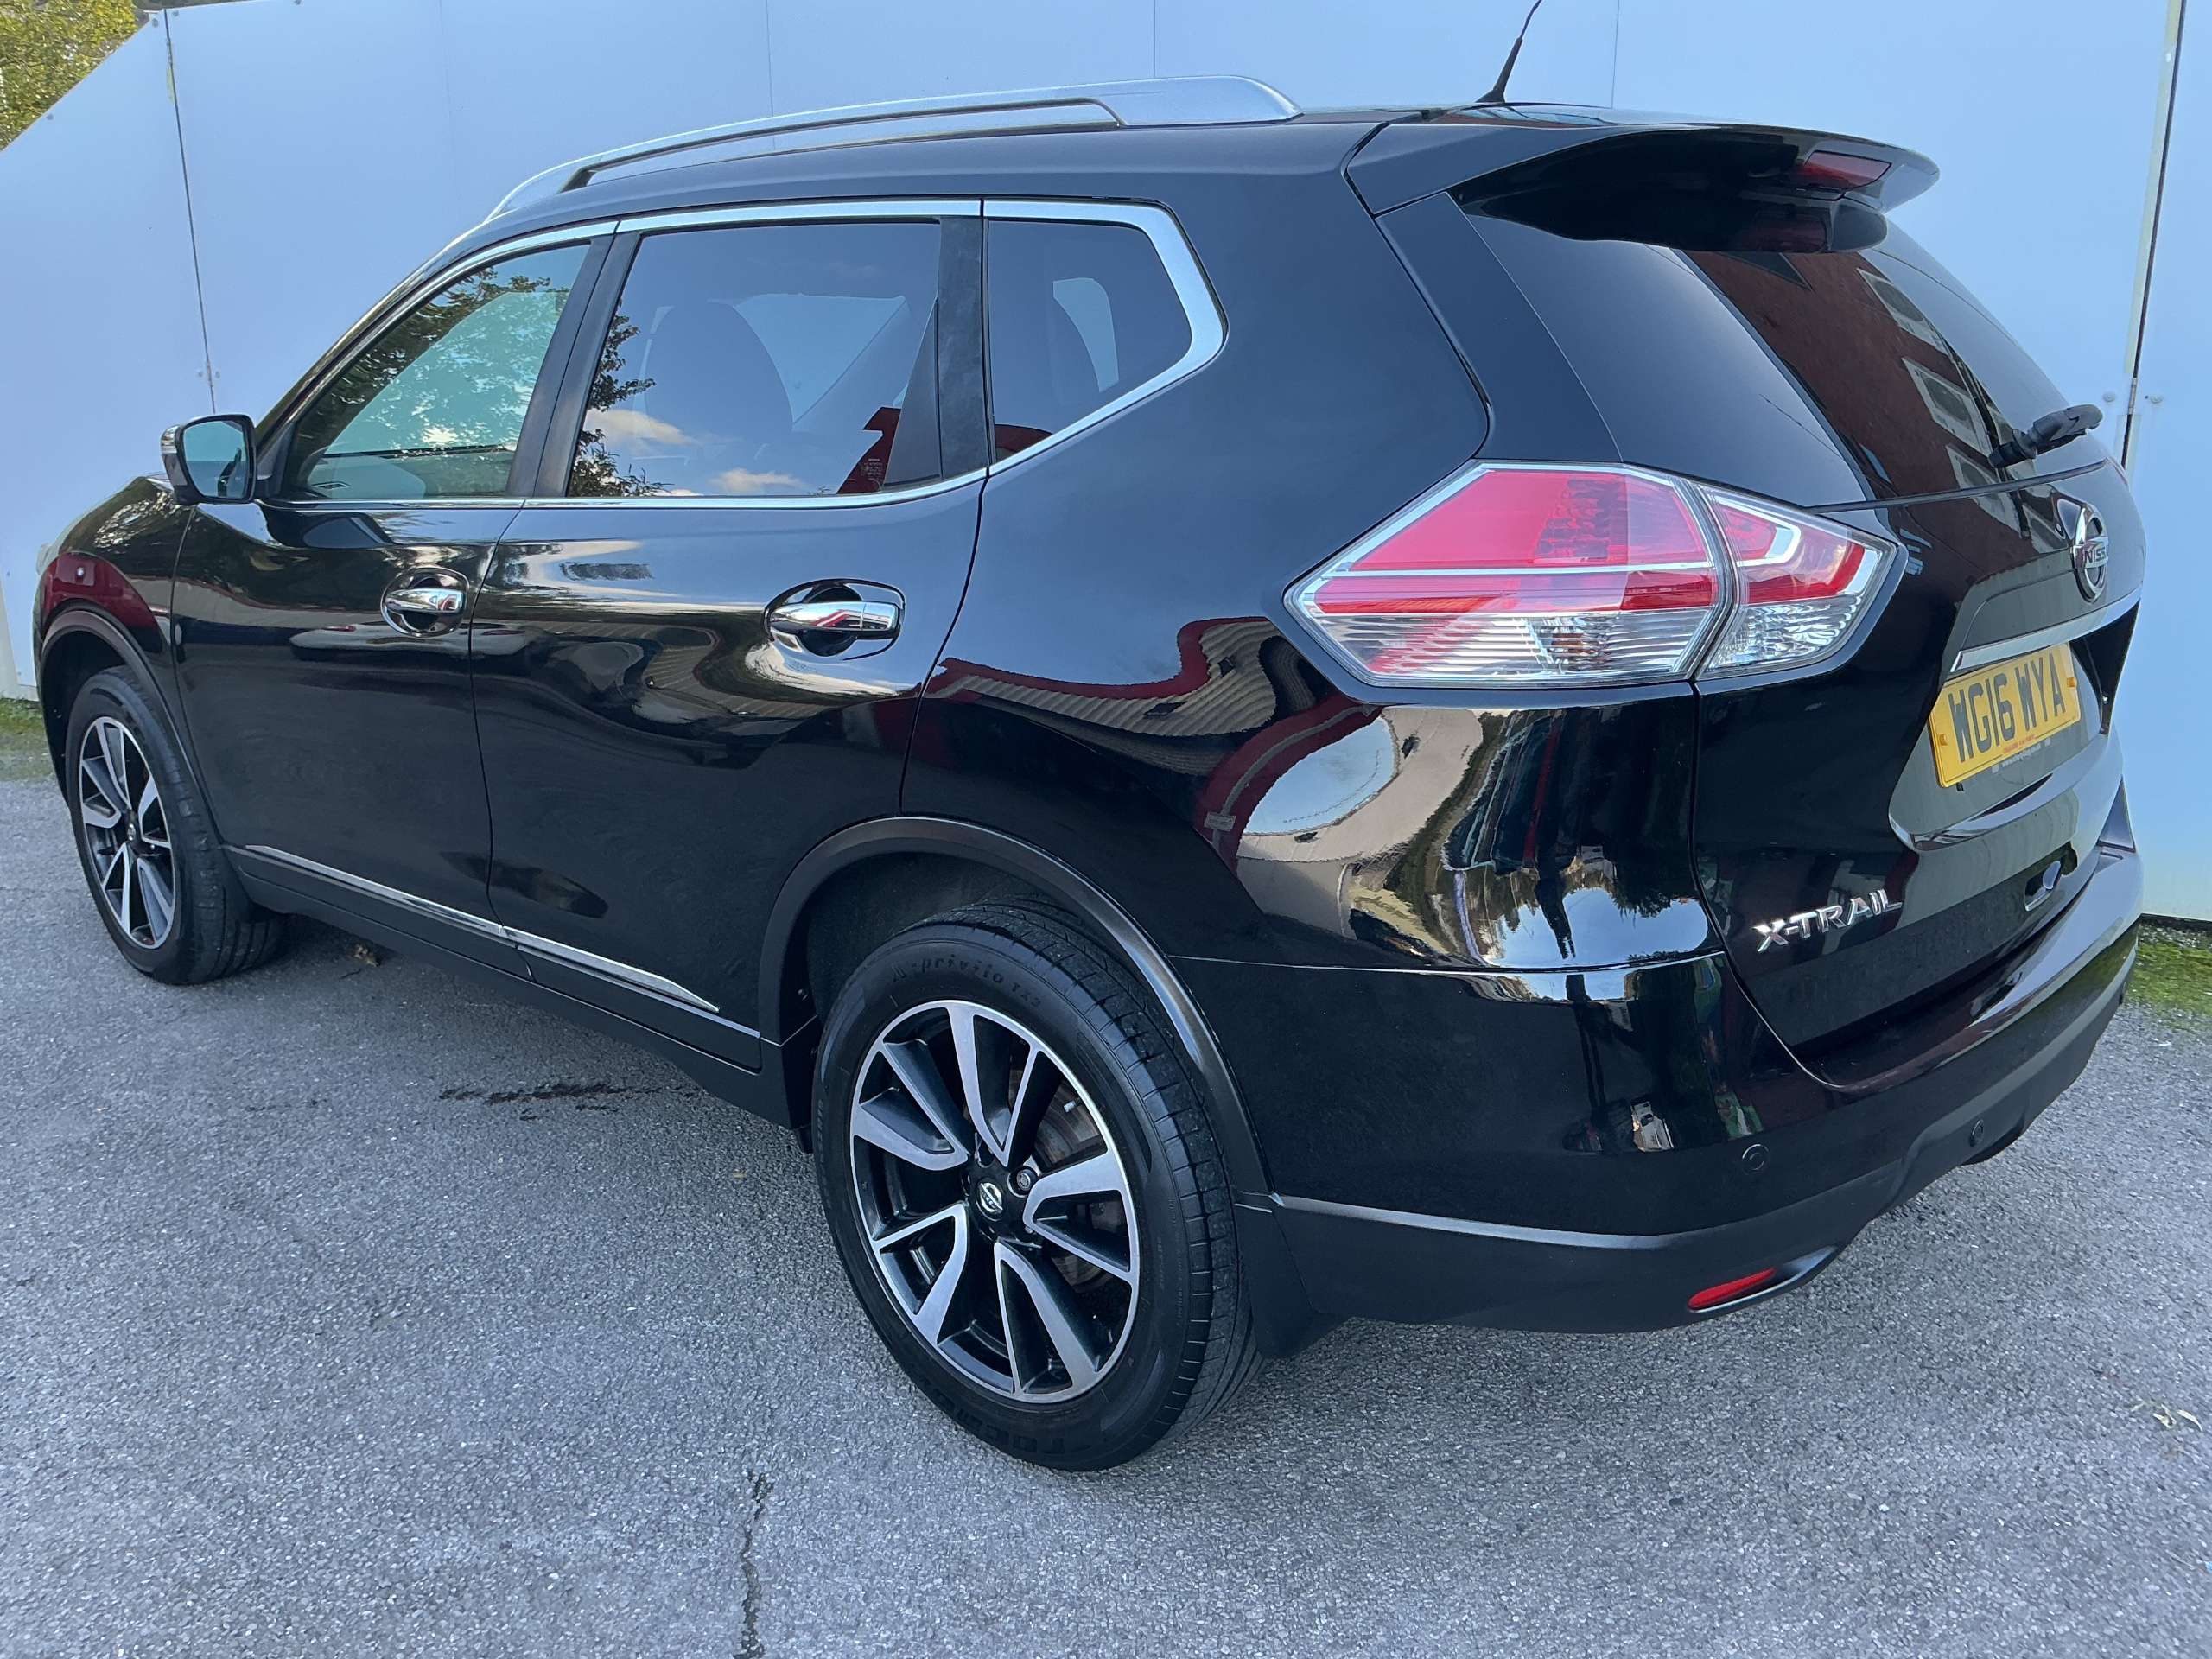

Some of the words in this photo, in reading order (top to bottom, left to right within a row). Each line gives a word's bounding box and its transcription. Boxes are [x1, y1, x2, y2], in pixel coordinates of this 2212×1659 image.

[1948, 673, 2016, 762] WG16
[2015, 652, 2066, 732] WYA
[1751, 889, 1902, 952] X-TRAIL
